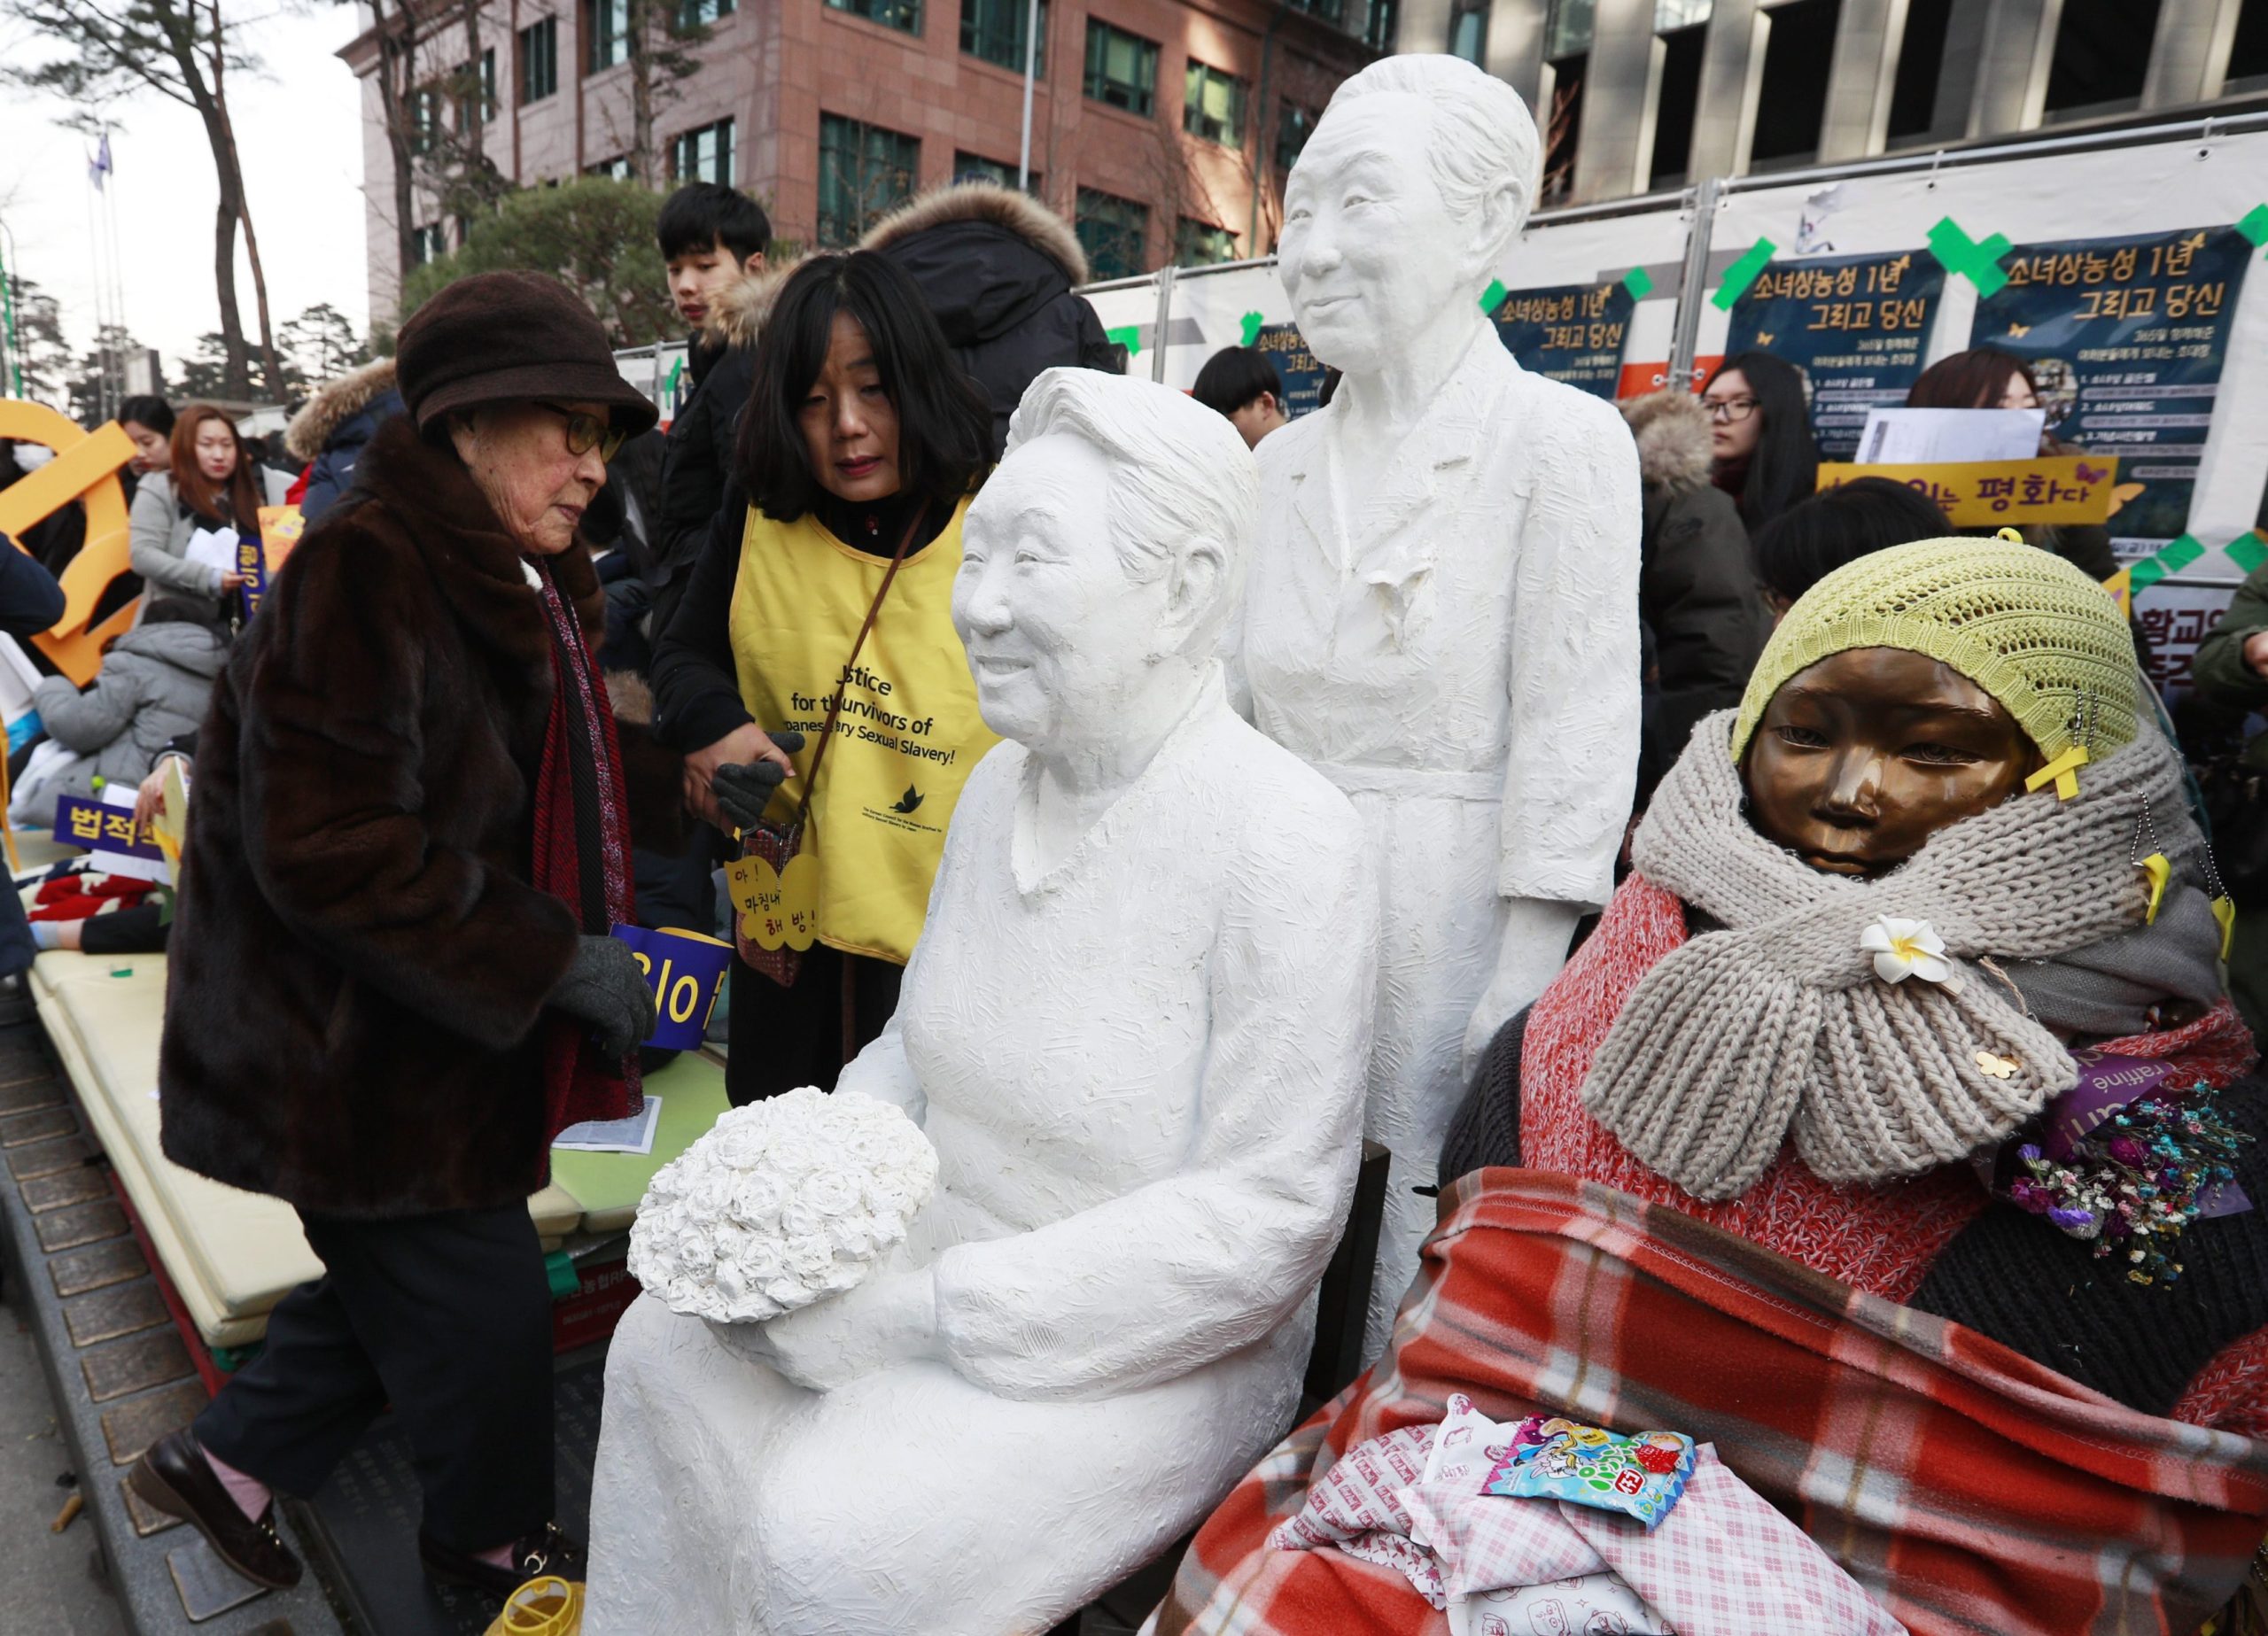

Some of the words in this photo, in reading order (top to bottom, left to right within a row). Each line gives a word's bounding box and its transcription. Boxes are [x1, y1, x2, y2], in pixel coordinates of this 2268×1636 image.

[1753, 267, 1857, 299] 소녀상농성
[2008, 246, 2138, 286] 소녀상농성
[1501, 295, 1575, 322] 소녀상농성
[1806, 302, 1873, 331] 그리고
[1879, 299, 1925, 330] 당신
[2073, 287, 2156, 320] 그리고
[2165, 282, 2225, 318] 당신
[1541, 325, 1586, 350] 그리고
[1588, 322, 1623, 349] 당신
[1977, 473, 2089, 512] 평화다
[791, 692, 816, 711] for
[911, 717, 934, 736] of
[858, 725, 897, 750] Sexual
[900, 740, 956, 766] Slavery!
[744, 893, 780, 914] 마침내
